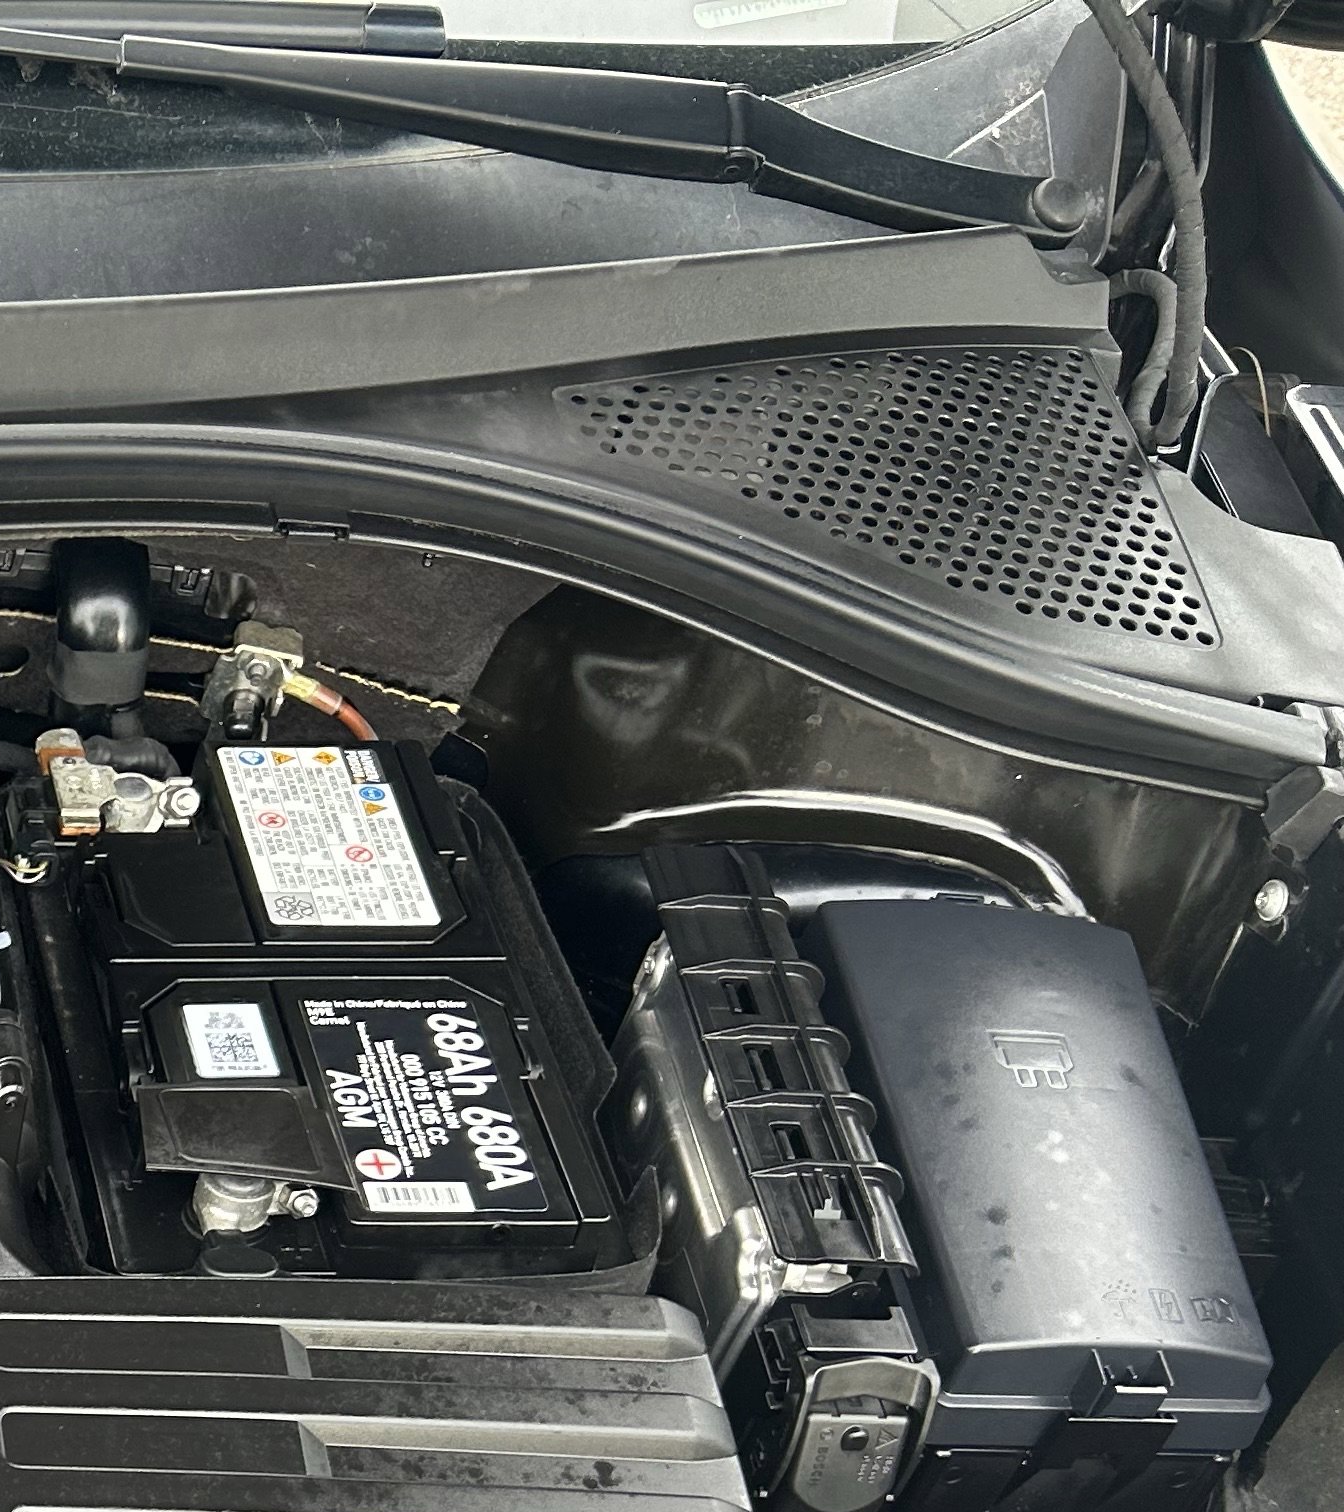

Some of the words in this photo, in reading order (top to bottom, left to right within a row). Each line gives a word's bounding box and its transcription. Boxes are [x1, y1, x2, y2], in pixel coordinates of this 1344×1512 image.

[400, 1053, 425, 1076] 000
[427, 1012, 497, 1096] 68Ah
[409, 1078, 432, 1100] 915
[429, 1070, 446, 1087] 12V
[325, 1068, 377, 1127] AGM
[417, 1103, 441, 1124] 105
[427, 1127, 449, 1145] CC
[461, 1106, 536, 1191] 680A
